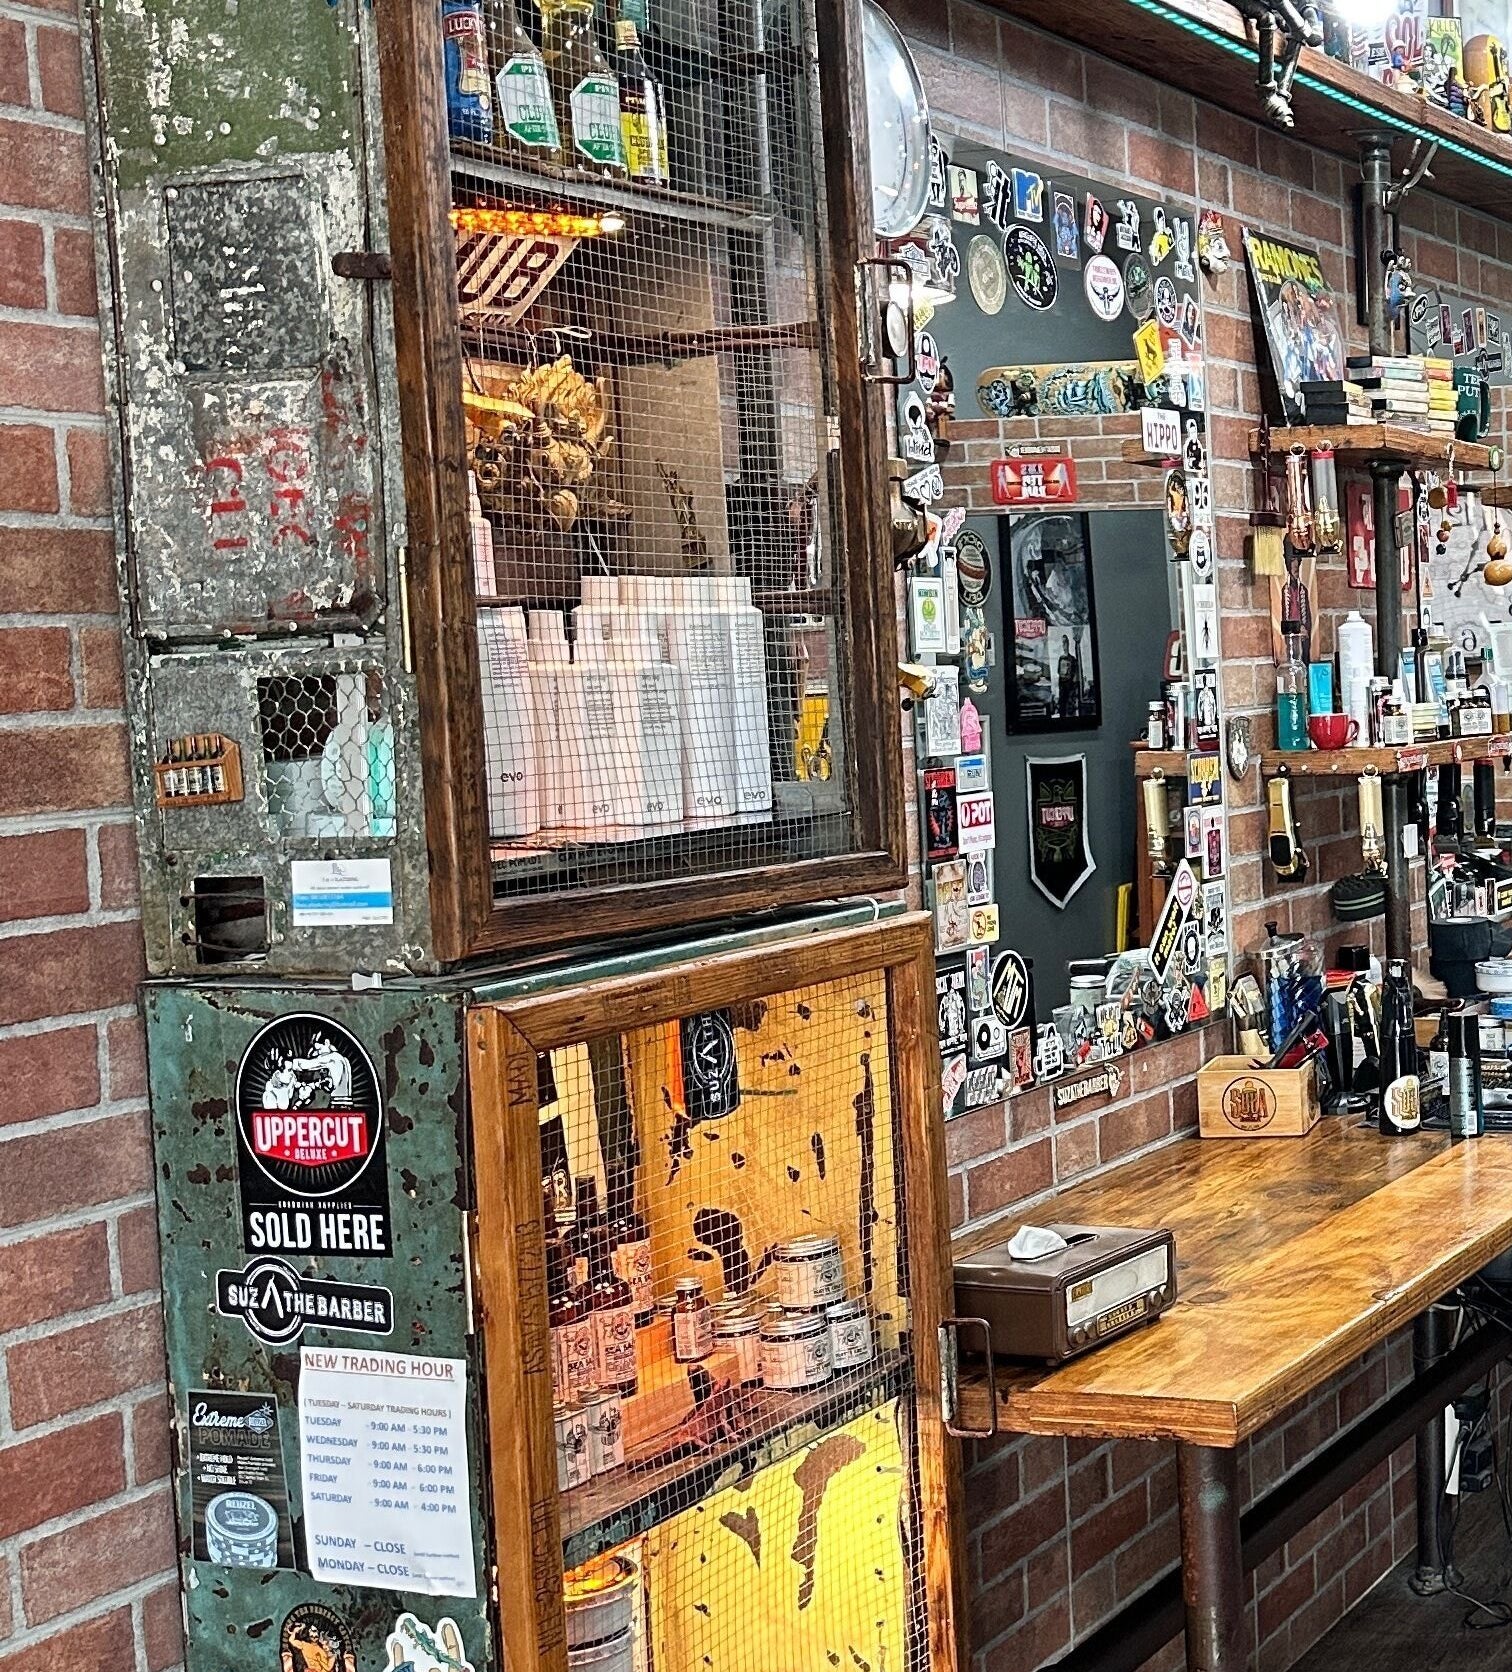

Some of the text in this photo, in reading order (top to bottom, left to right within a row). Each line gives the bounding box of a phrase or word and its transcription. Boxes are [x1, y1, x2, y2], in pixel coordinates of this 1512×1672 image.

[1249, 236, 1325, 286] RAMONES
[1146, 422, 1178, 450] HIPPO
[500, 771, 523, 783] evo
[696, 795, 723, 806] evo
[743, 790, 766, 801] evo
[591, 804, 611, 814] evo
[646, 801, 664, 812] evo
[255, 1115, 365, 1154] UPPERCUT
[294, 1148, 327, 1161] DELUXE
[250, 1211, 386, 1251] SOLD HERE
[304, 1352, 454, 1379] NEW TRADING HOUR
[192, 1402, 246, 1428] Extreme
[305, 1416, 342, 1427] TUESDAY
[370, 1421, 389, 1432] 9:00
[390, 1422, 406, 1433] AM
[433, 1426, 448, 1436] PM
[199, 1427, 272, 1448] POMADE
[306, 1435, 358, 1447] WEDNESDAY
[371, 1440, 390, 1450] 9:00
[391, 1442, 406, 1452] AM
[433, 1446, 449, 1456] PM
[307, 1453, 351, 1466] THURSDAY
[373, 1459, 392, 1470] 9:00
[393, 1461, 408, 1471] AM
[438, 1465, 453, 1475] PM
[309, 1473, 337, 1483] FRIDAY
[372, 1479, 391, 1490] 9:00
[392, 1481, 407, 1490] AM
[440, 1484, 455, 1494] PM
[310, 1491, 456, 1514] SATURDAY 9:00 AM 4:00 PM
[315, 1534, 357, 1549] SUNDAY
[374, 1541, 407, 1555] CLOSE
[317, 1557, 365, 1572] MONDAY
[377, 1563, 410, 1577] CLOSE
